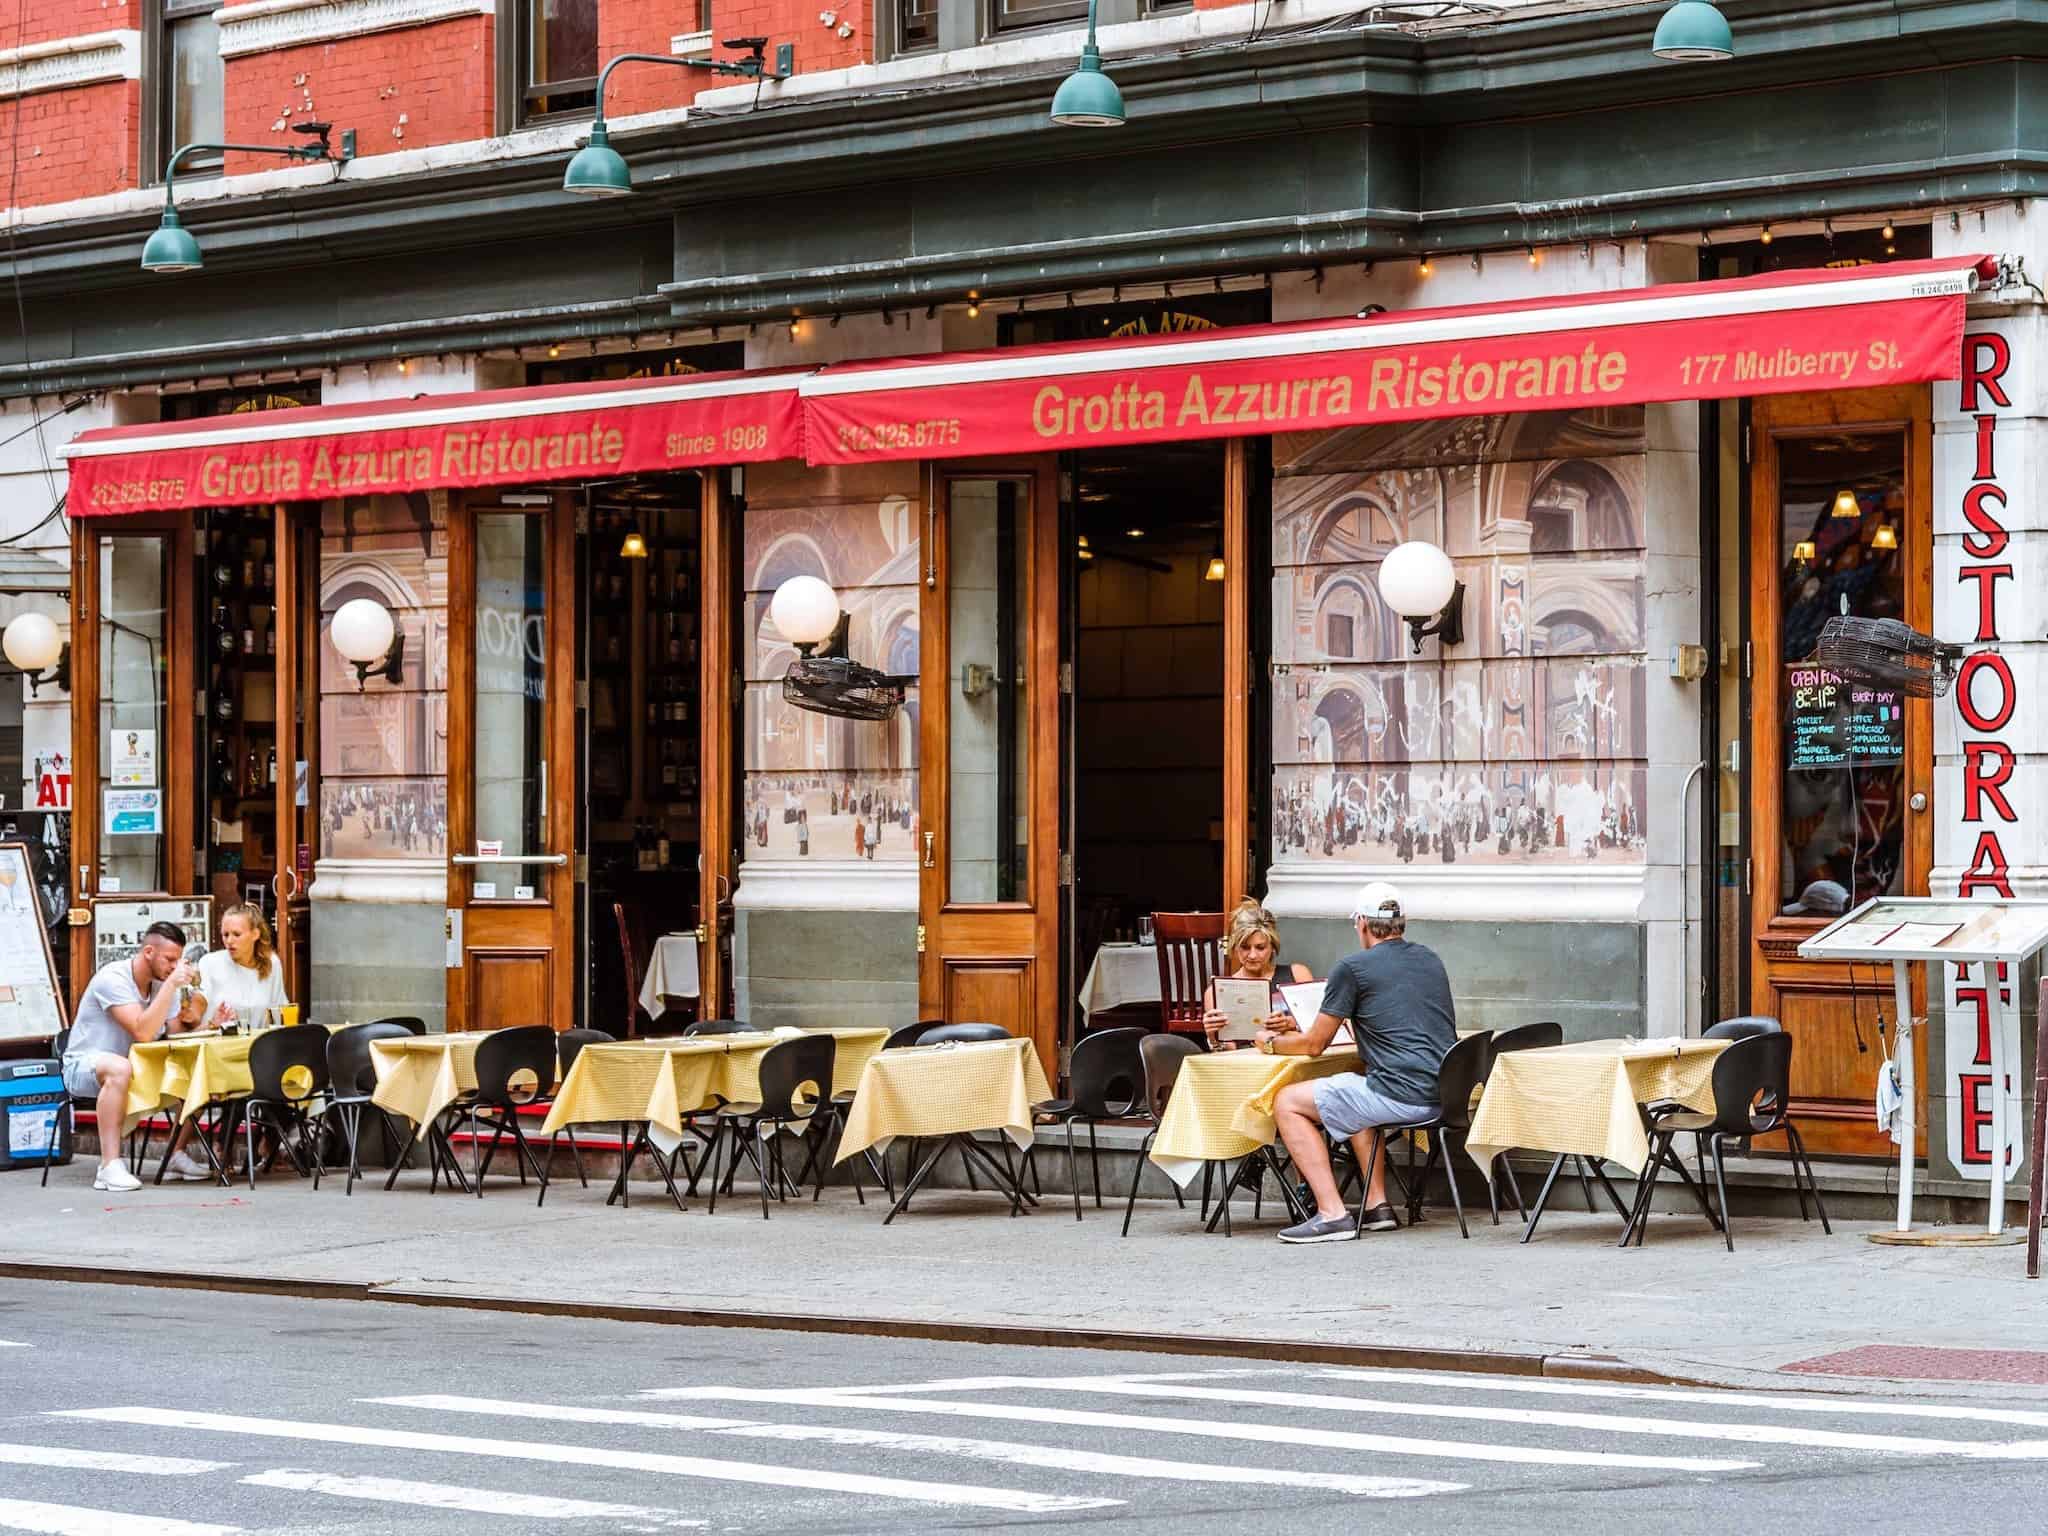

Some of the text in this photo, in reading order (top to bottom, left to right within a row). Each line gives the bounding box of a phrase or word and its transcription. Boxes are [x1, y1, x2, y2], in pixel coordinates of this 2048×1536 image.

[1679, 341, 1904, 385] 177 Mulberry St.
[1033, 341, 1627, 438] Grotta Azzurra Ristorante
[202, 424, 624, 499] Grotta Azzurra Ristorante
[666, 425, 768, 459] Since 1908
[1791, 670, 1819, 687] OPEN
[1851, 691, 1896, 705] EVERY DAY
